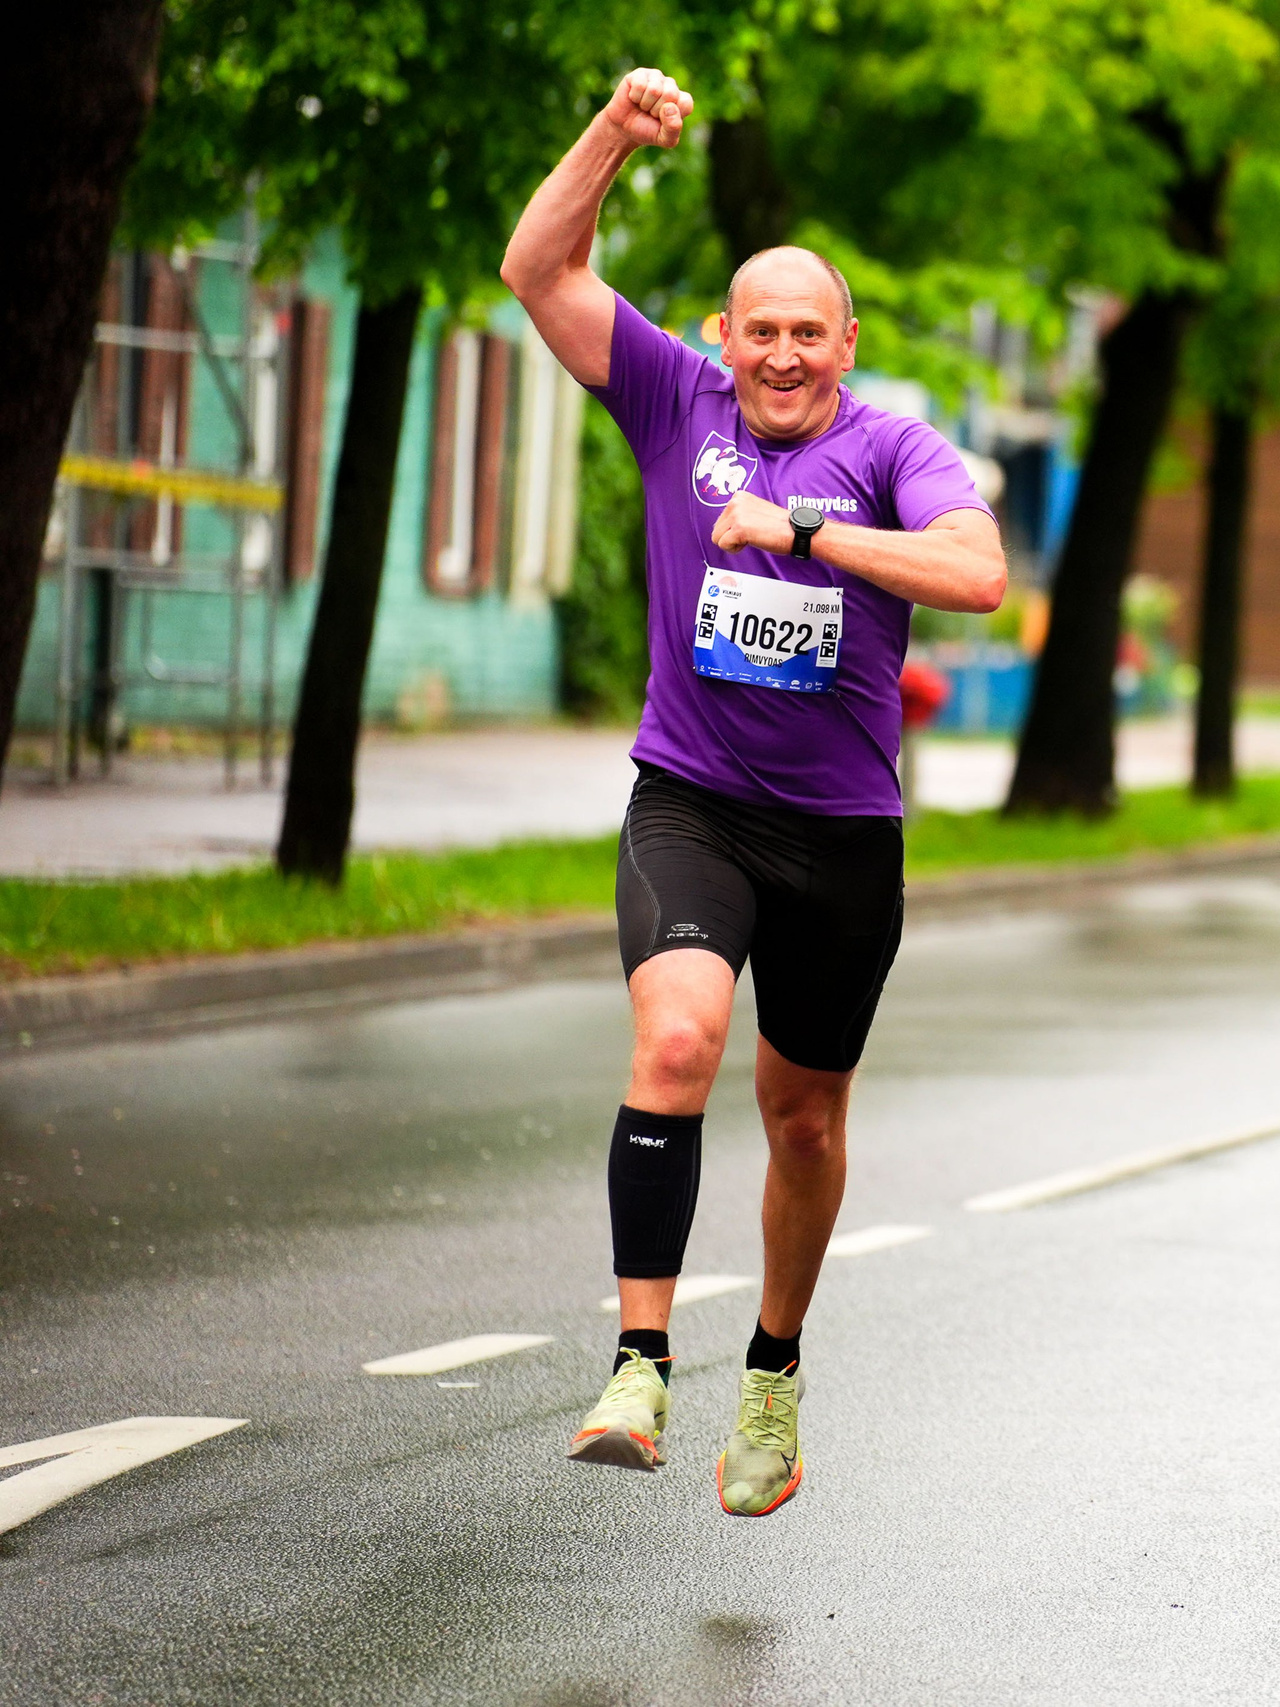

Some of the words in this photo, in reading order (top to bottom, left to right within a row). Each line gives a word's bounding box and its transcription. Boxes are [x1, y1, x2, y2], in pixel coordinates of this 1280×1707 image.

[787, 495, 858, 512] Rimvydas
[830, 604, 840, 614] KM
[730, 612, 813, 655] 10622
[744, 653, 783, 668] RIMVYDAS
